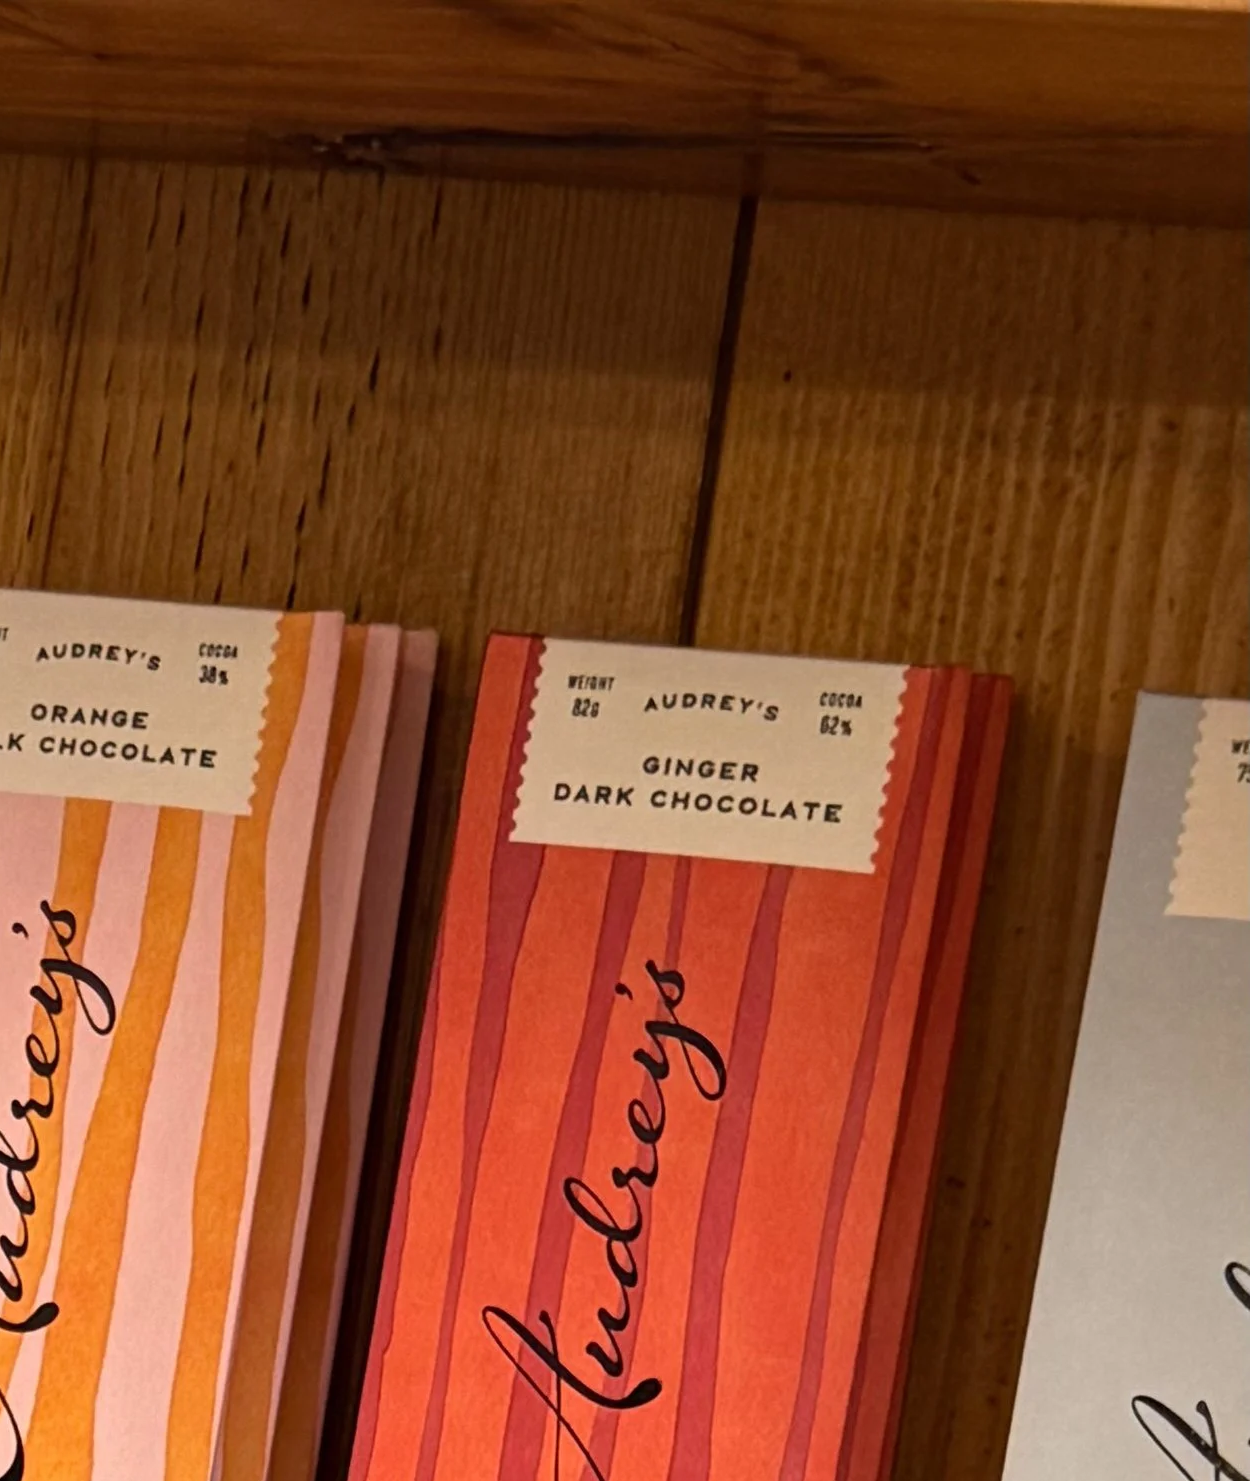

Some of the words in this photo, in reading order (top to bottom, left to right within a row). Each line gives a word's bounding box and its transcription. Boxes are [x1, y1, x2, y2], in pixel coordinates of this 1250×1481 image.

[35, 642, 162, 672] AUDREY'S
[567, 675, 615, 692] WEIGHT
[643, 693, 780, 722] AUDREY'S
[819, 691, 863, 709] COCOA
[30, 702, 150, 731] ORANGE
[38, 735, 218, 770] CHOCOLATE
[642, 755, 761, 784] GINGER
[553, 782, 635, 808] DARK
[650, 789, 843, 824] CHOCOLATE
